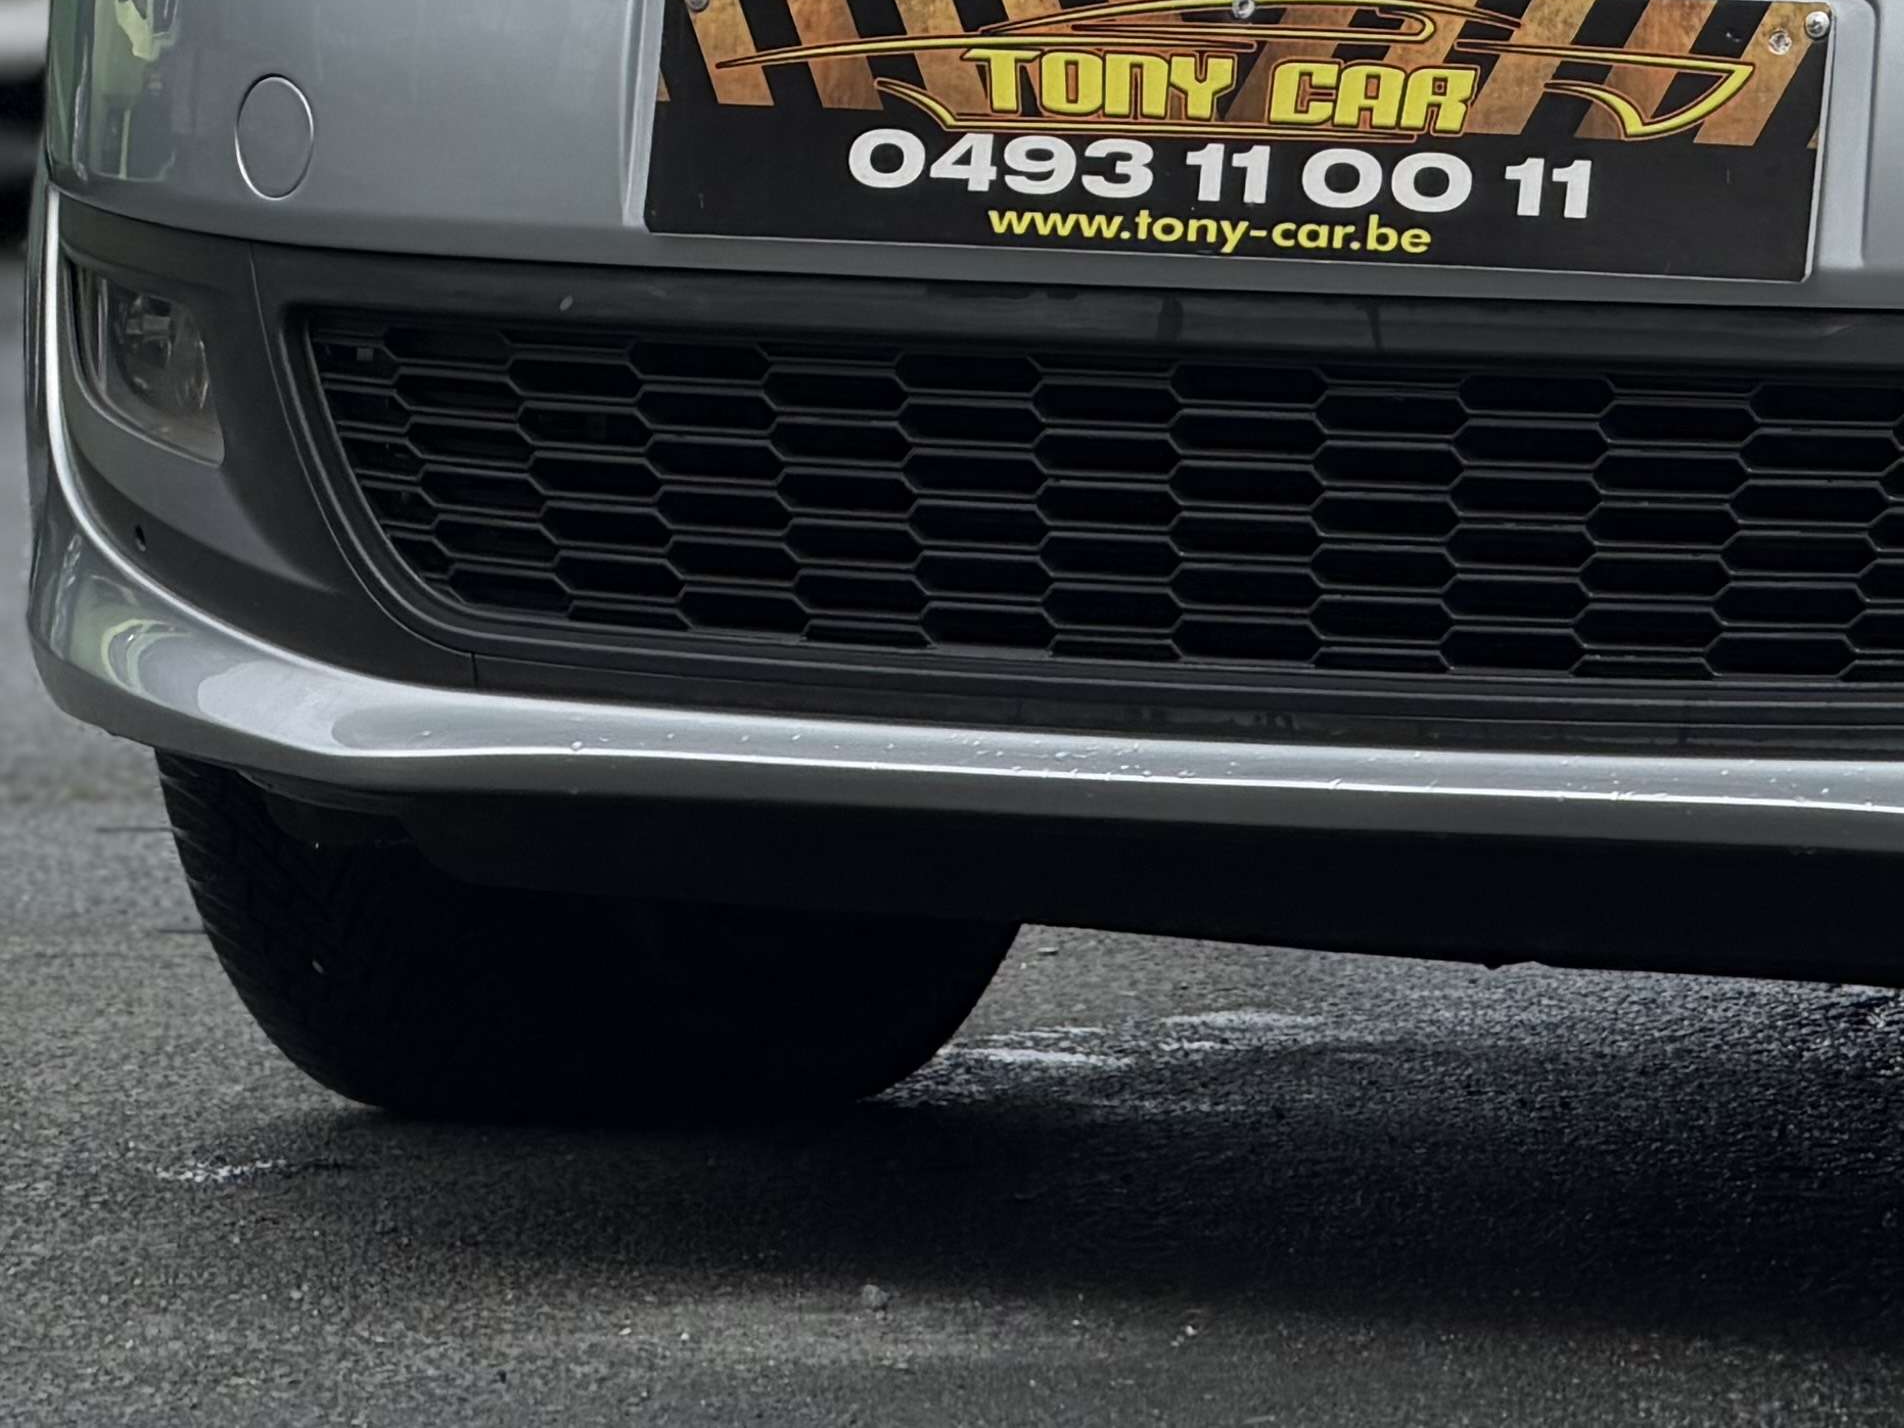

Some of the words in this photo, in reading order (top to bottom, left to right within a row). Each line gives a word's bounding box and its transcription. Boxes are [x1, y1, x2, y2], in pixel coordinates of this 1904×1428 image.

[963, 47, 1234, 121] TONY
[1268, 61, 1477, 134] CAR
[848, 128, 1154, 199] 0493
[1185, 142, 1271, 204] 11
[1301, 147, 1473, 213] 00
[1504, 157, 1592, 219] 11
[988, 207, 1432, 254] www.tony-car.be
